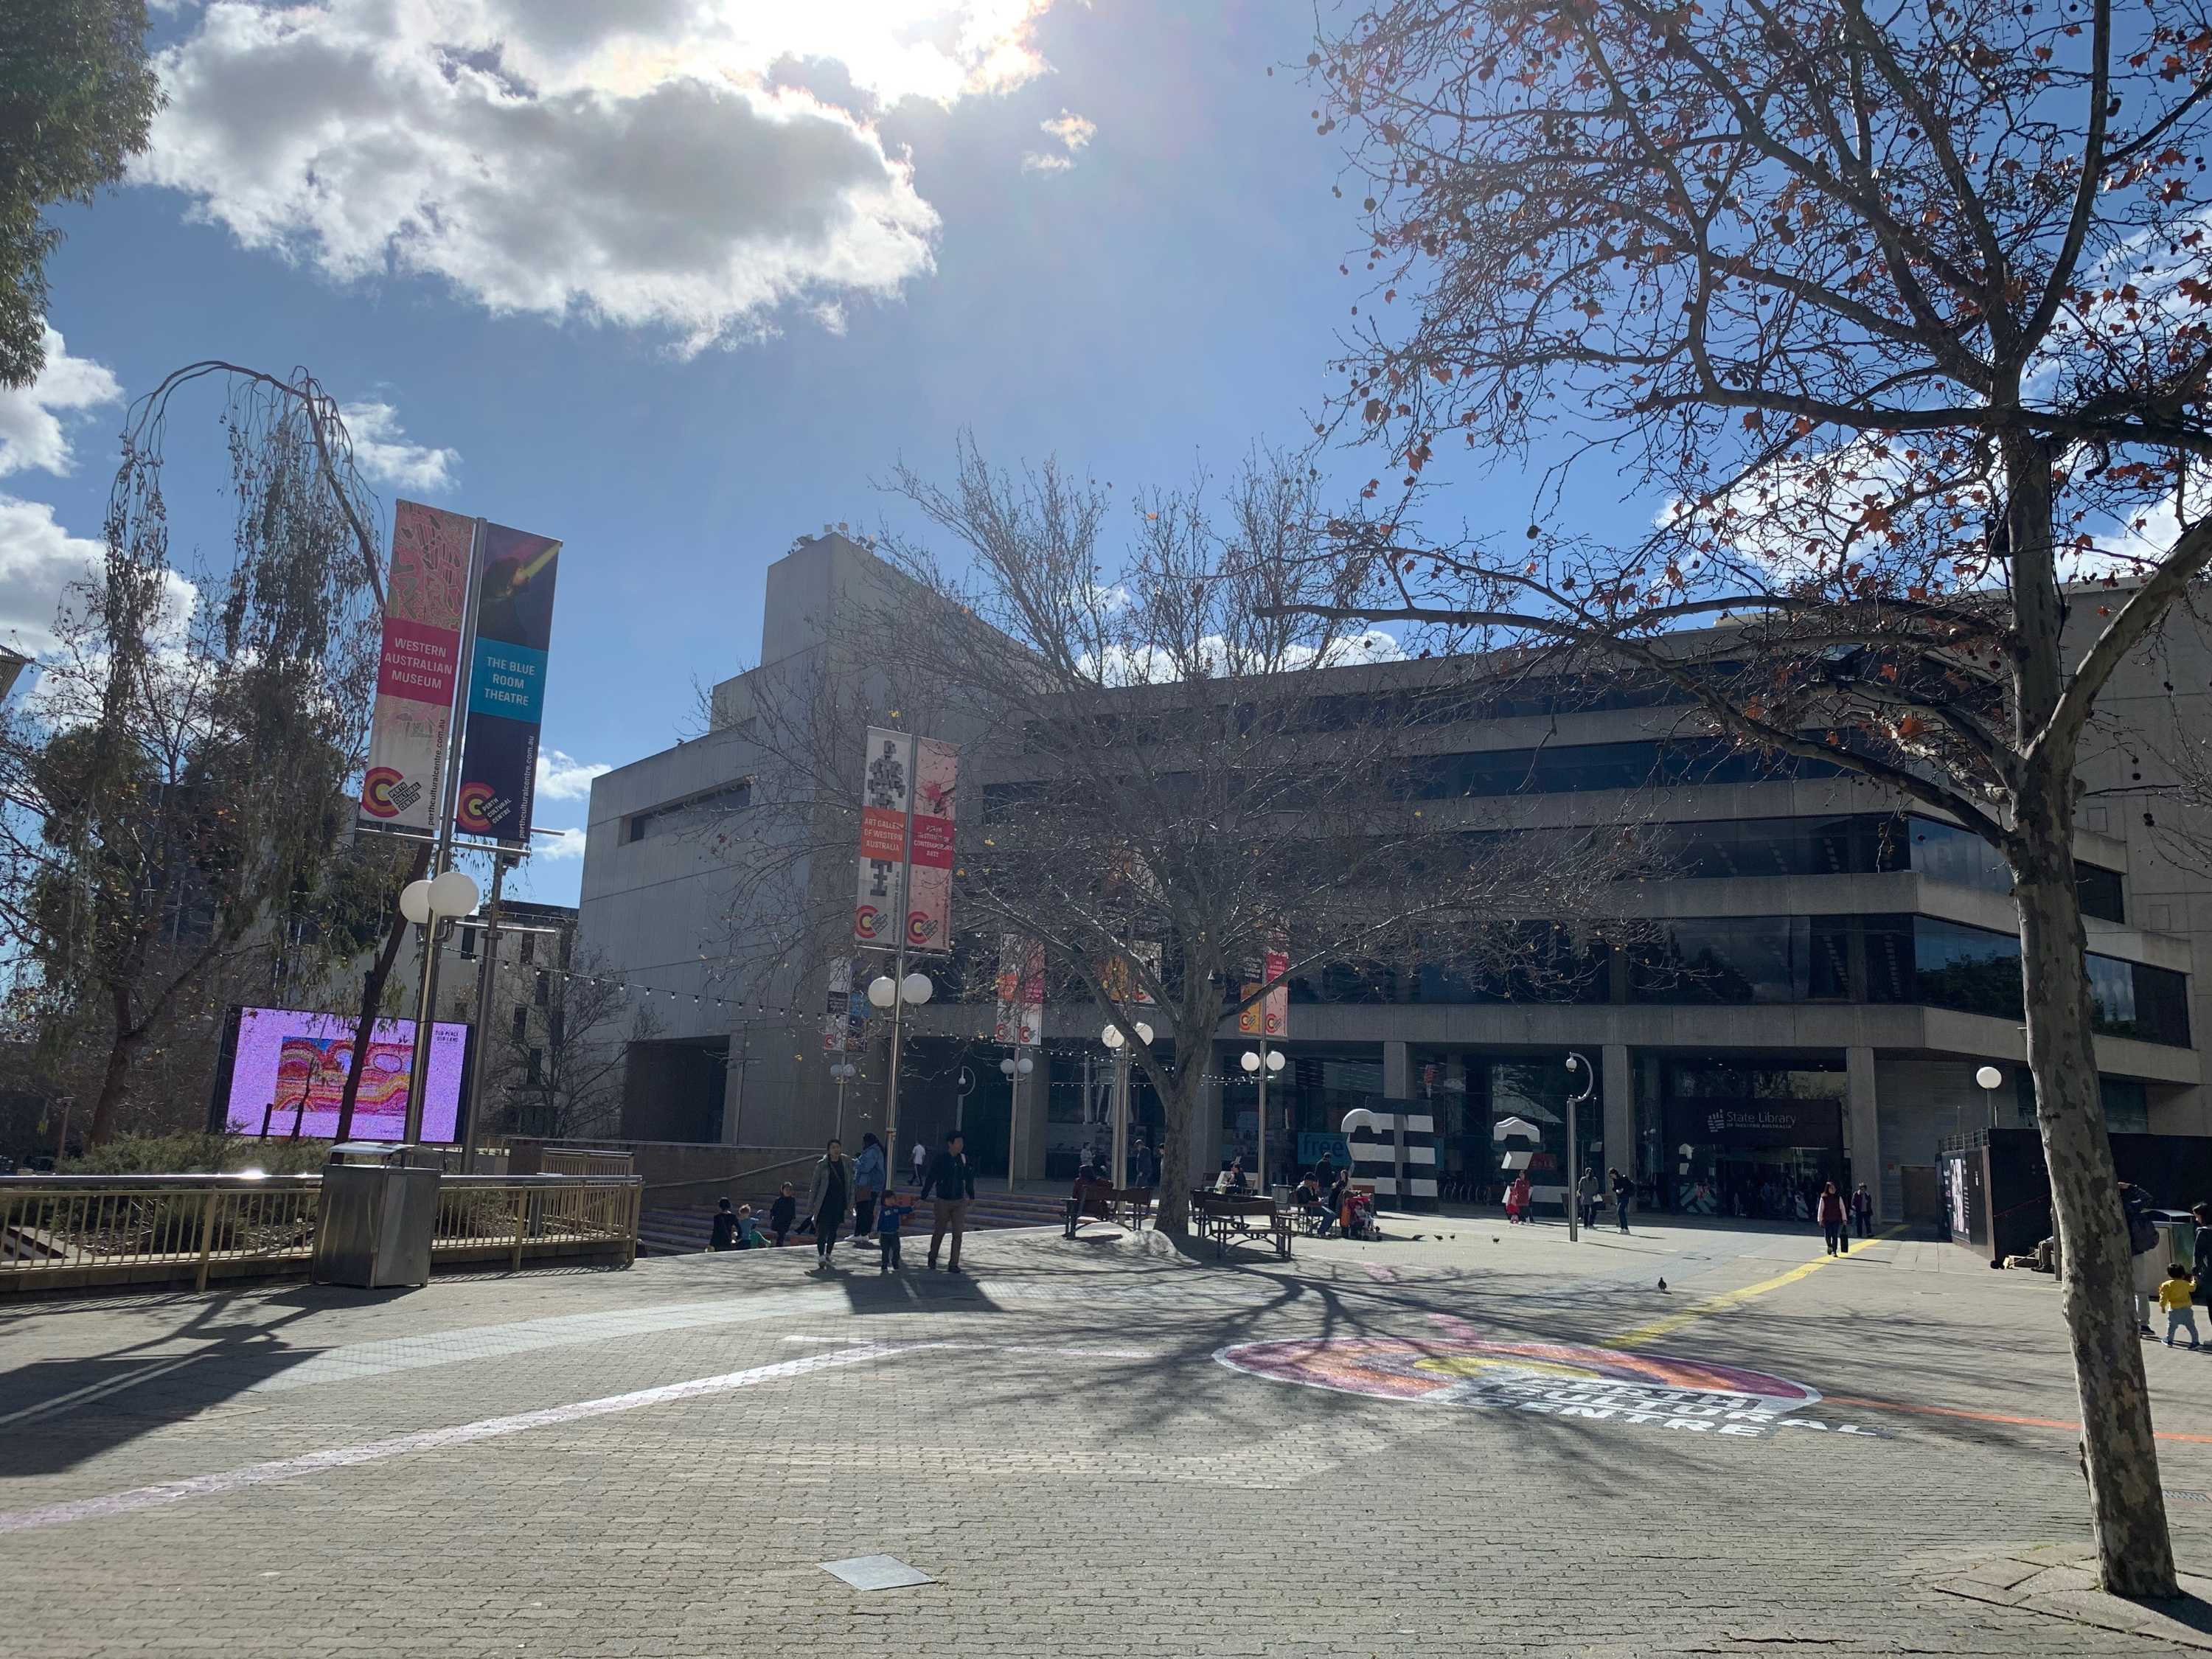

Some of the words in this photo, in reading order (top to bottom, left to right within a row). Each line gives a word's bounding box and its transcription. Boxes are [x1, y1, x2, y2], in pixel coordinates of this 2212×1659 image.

[394, 637, 447, 657] WESTERN
[384, 653, 453, 675] AUSTRALIAN
[487, 656, 507, 670] THE
[509, 661, 536, 675] BLUE
[392, 669, 442, 689] MUSEUM
[493, 674, 524, 689] ROOM
[484, 688, 530, 706] THEATRE
[428, 719, 446, 826] perthculturalcentre.com.au
[389, 782, 407, 799] PERTH
[394, 782, 421, 805] CULTURAL
[518, 736, 535, 839] perthculturalcentre.com.au
[400, 793, 420, 811] CENTRE
[481, 797, 499, 812] PERTH
[487, 799, 512, 818] CULTURAL
[492, 808, 511, 824] CENTRE
[864, 818, 877, 826] ART
[864, 828, 872, 836] OF
[873, 830, 903, 841] WESTERN
[866, 840, 900, 851] AUSTRALIA
[1727, 1111, 1755, 1121] State
[1759, 1110, 1796, 1126] Library
[1303, 1134, 1343, 1156] free
[1497, 1385, 1877, 1436] CULTURAL
